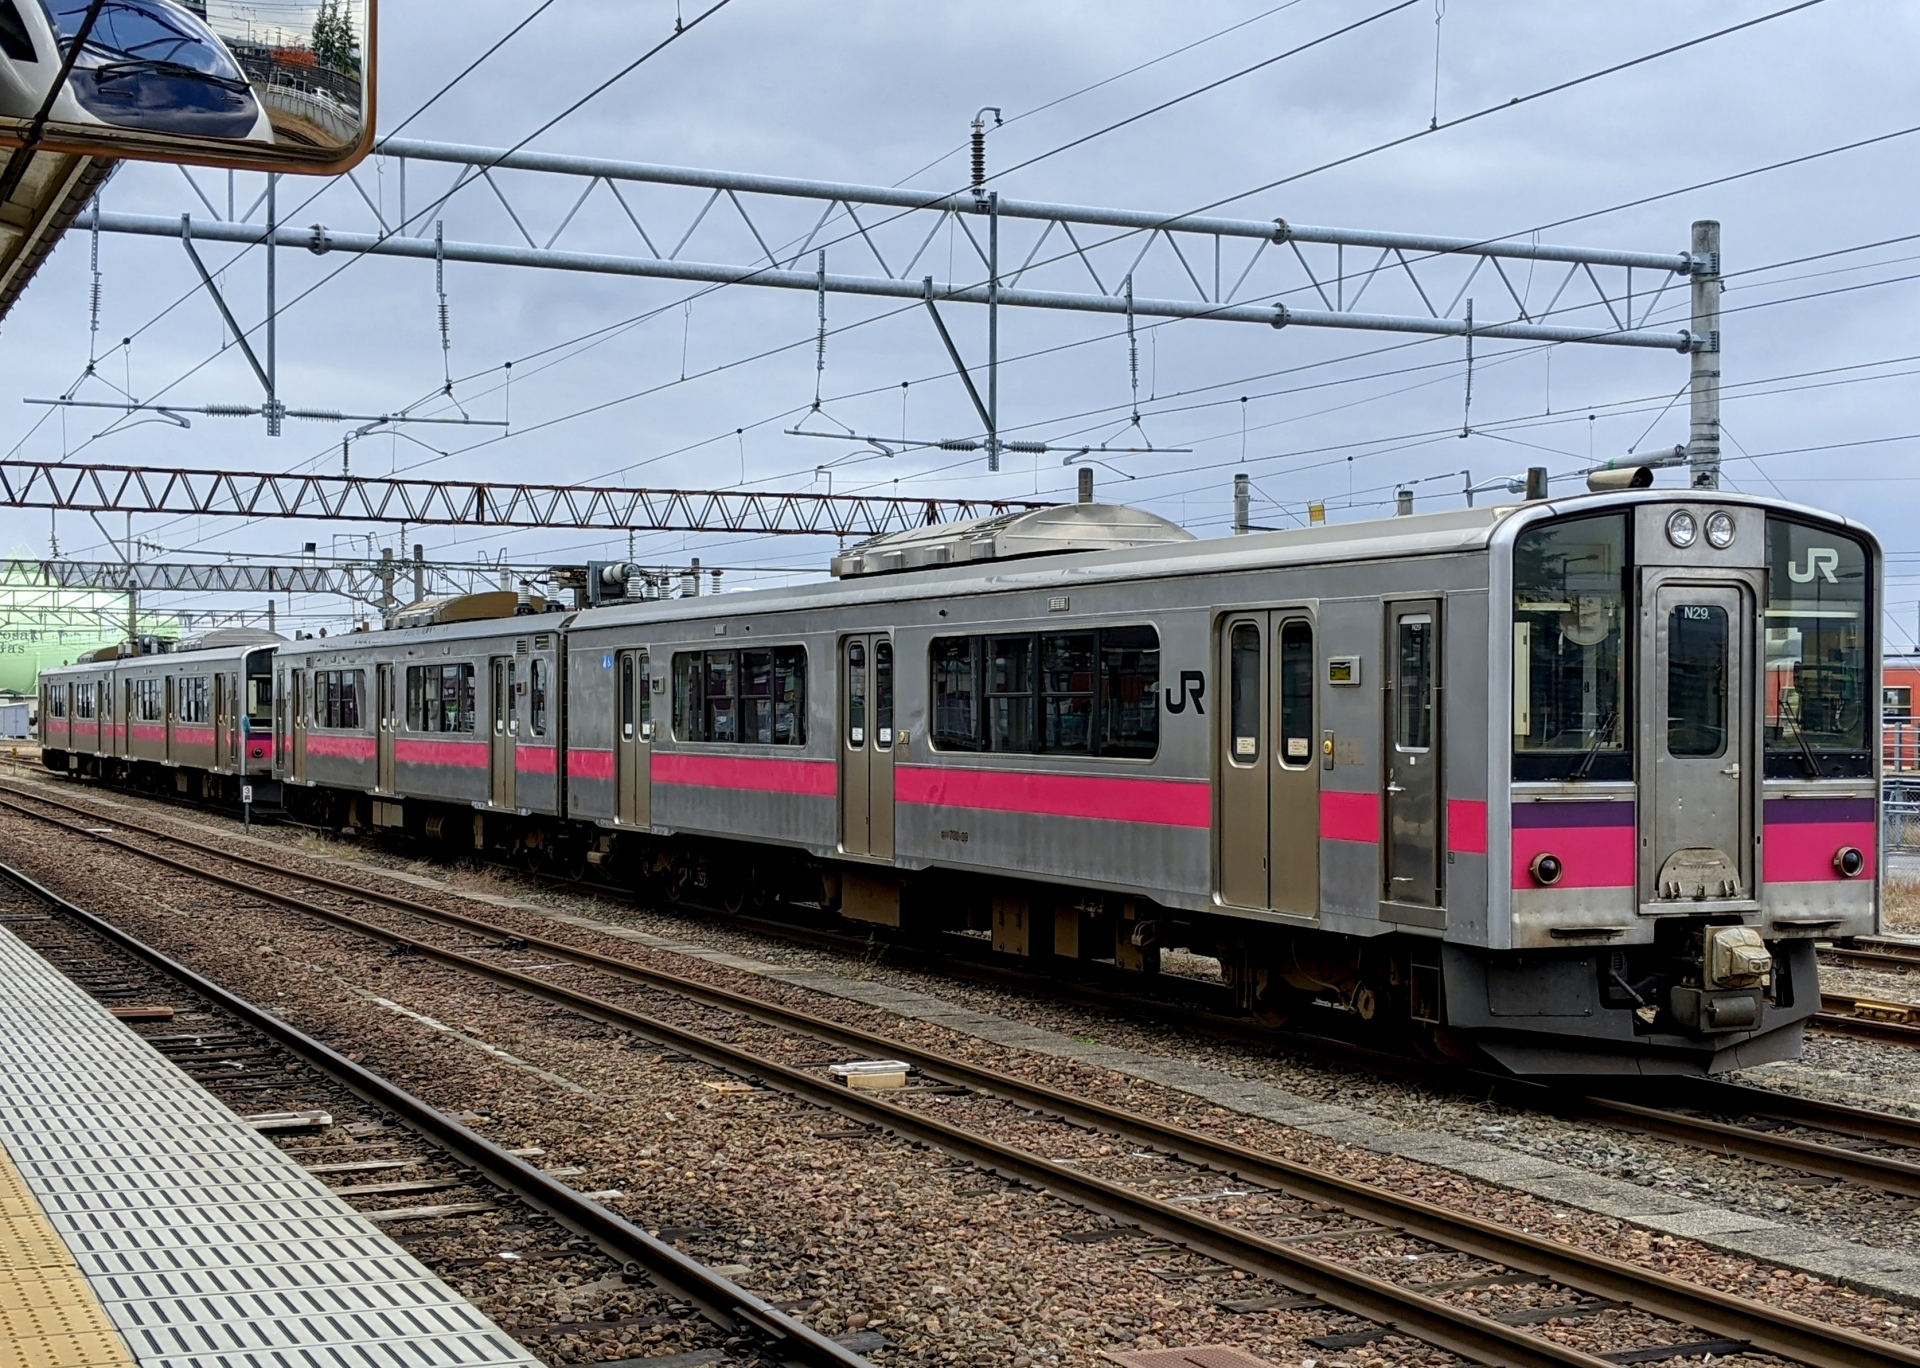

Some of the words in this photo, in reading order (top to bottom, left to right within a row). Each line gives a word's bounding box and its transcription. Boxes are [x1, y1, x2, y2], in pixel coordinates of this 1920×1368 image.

[1788, 548, 1839, 583] JR
[0, 629, 44, 640] osaki
[1165, 670, 1205, 714] JR
